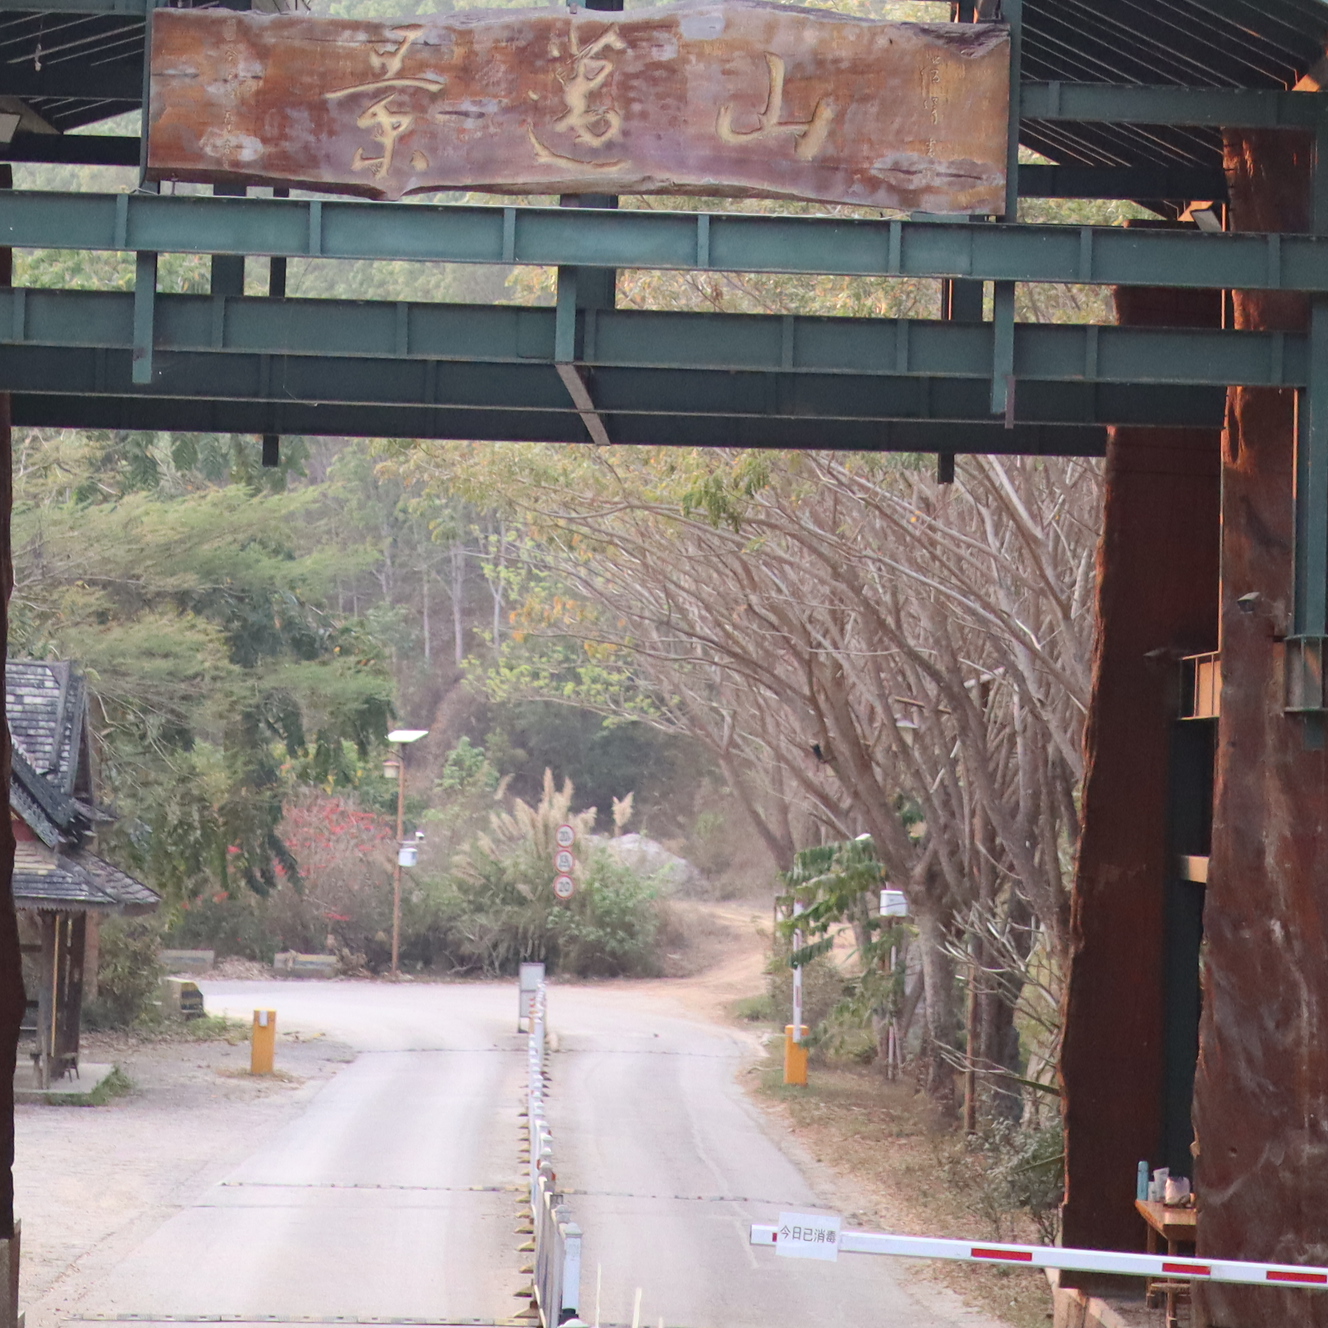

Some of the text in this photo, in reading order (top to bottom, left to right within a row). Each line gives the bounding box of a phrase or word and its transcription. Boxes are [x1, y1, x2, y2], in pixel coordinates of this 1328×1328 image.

[780, 1225, 837, 1244] 今日已消毒
